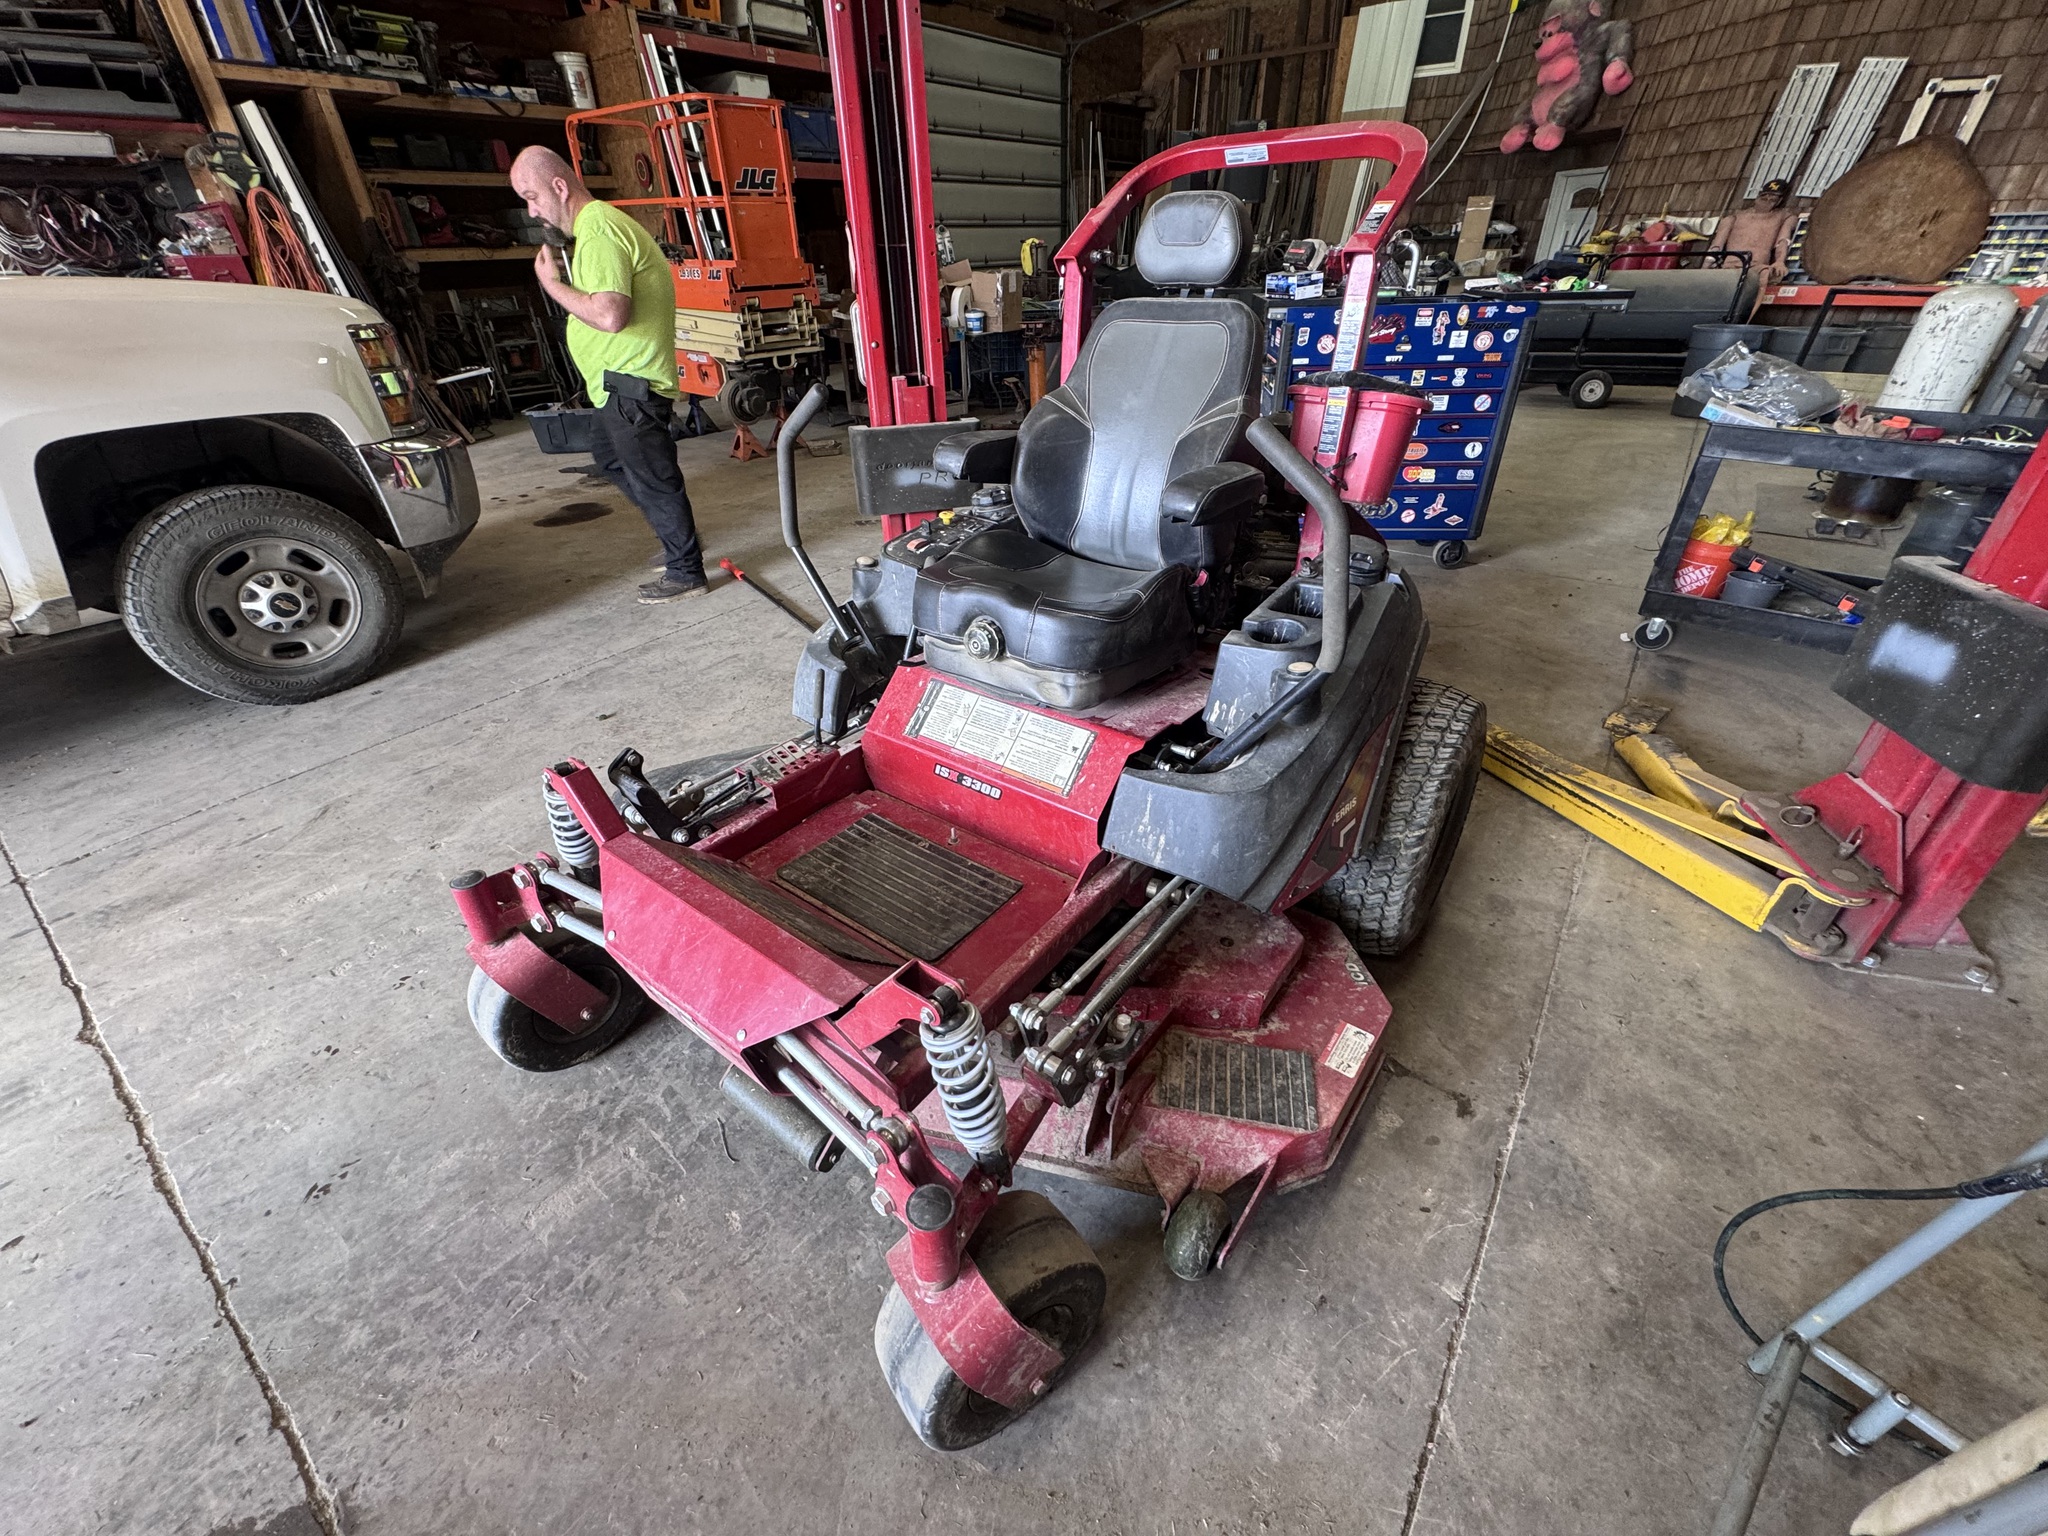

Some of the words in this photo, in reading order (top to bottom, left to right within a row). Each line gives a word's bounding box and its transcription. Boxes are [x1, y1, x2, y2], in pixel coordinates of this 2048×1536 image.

[735, 167, 777, 190] JLG
[708, 269, 722, 280] JLG
[919, 471, 950, 484] PR
[1678, 565, 1695, 577] THE
[1680, 577, 1709, 594] DEPOT
[934, 763, 960, 783] ISX
[961, 775, 1002, 799] 3300
